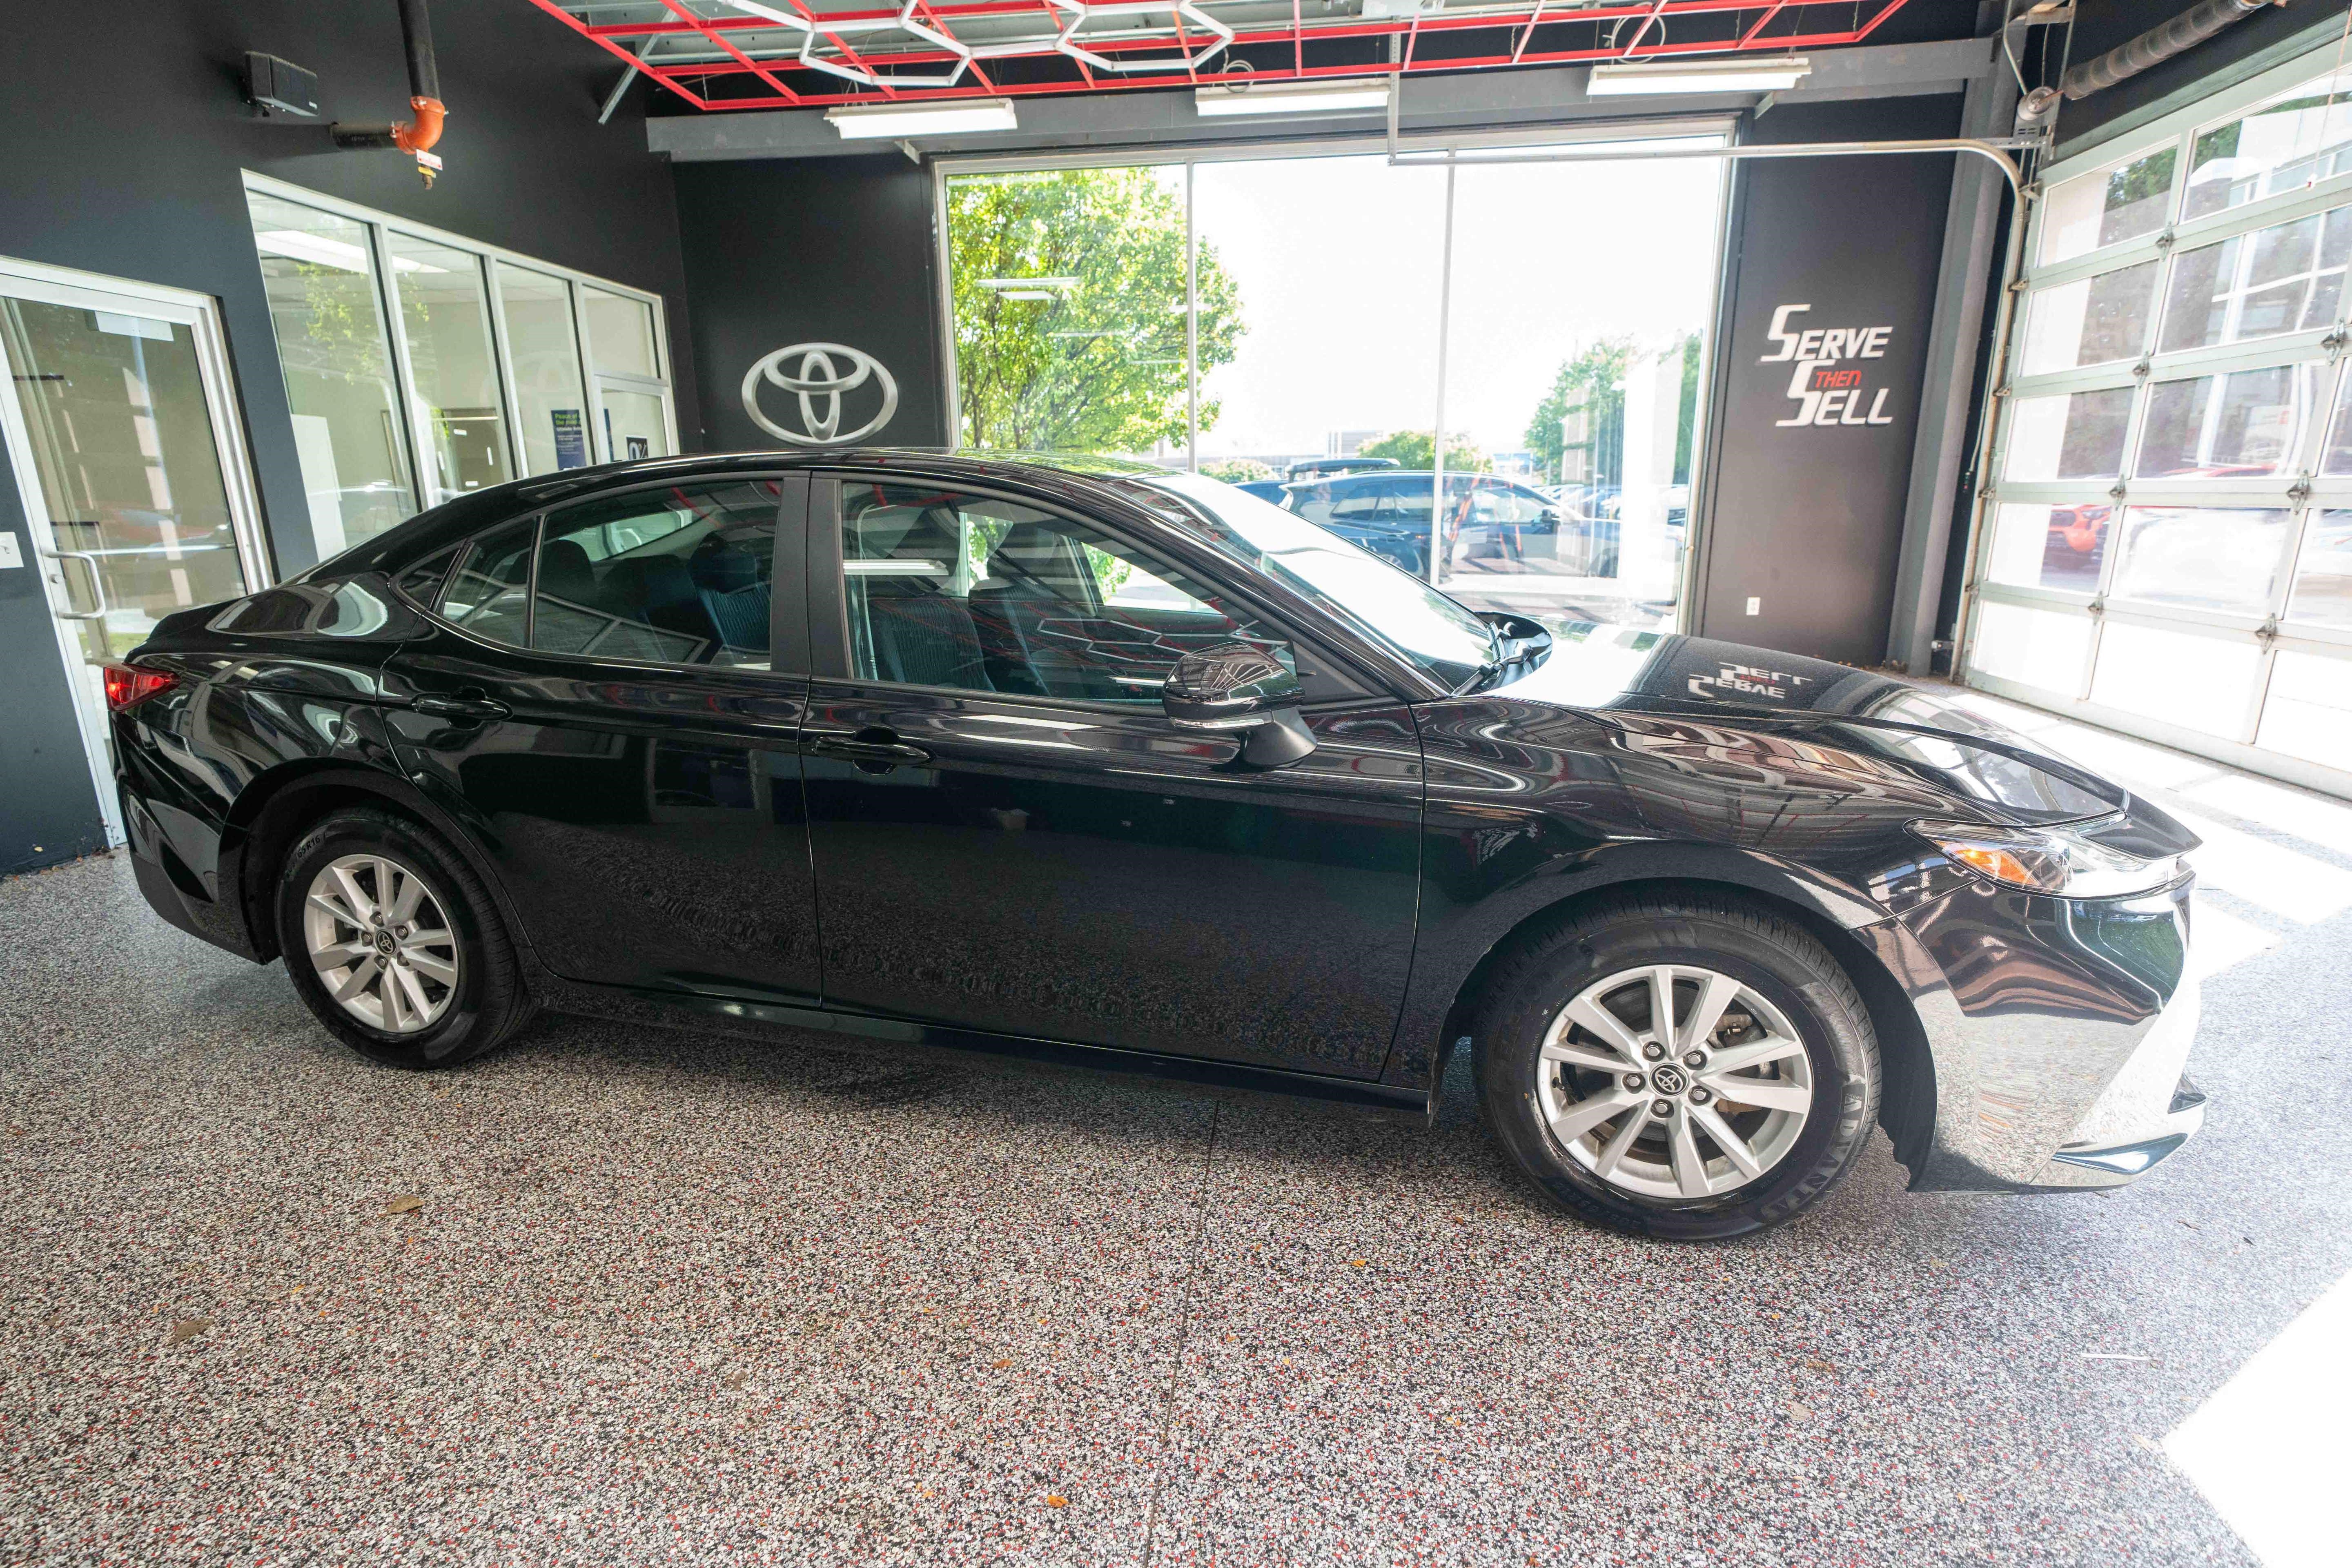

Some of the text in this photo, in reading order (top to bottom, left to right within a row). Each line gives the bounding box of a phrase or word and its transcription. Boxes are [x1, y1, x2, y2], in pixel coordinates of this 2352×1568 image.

[1760, 304, 1893, 362] SERVE
[1775, 359, 1893, 427] SELL
[1815, 370, 1862, 388] THEN
